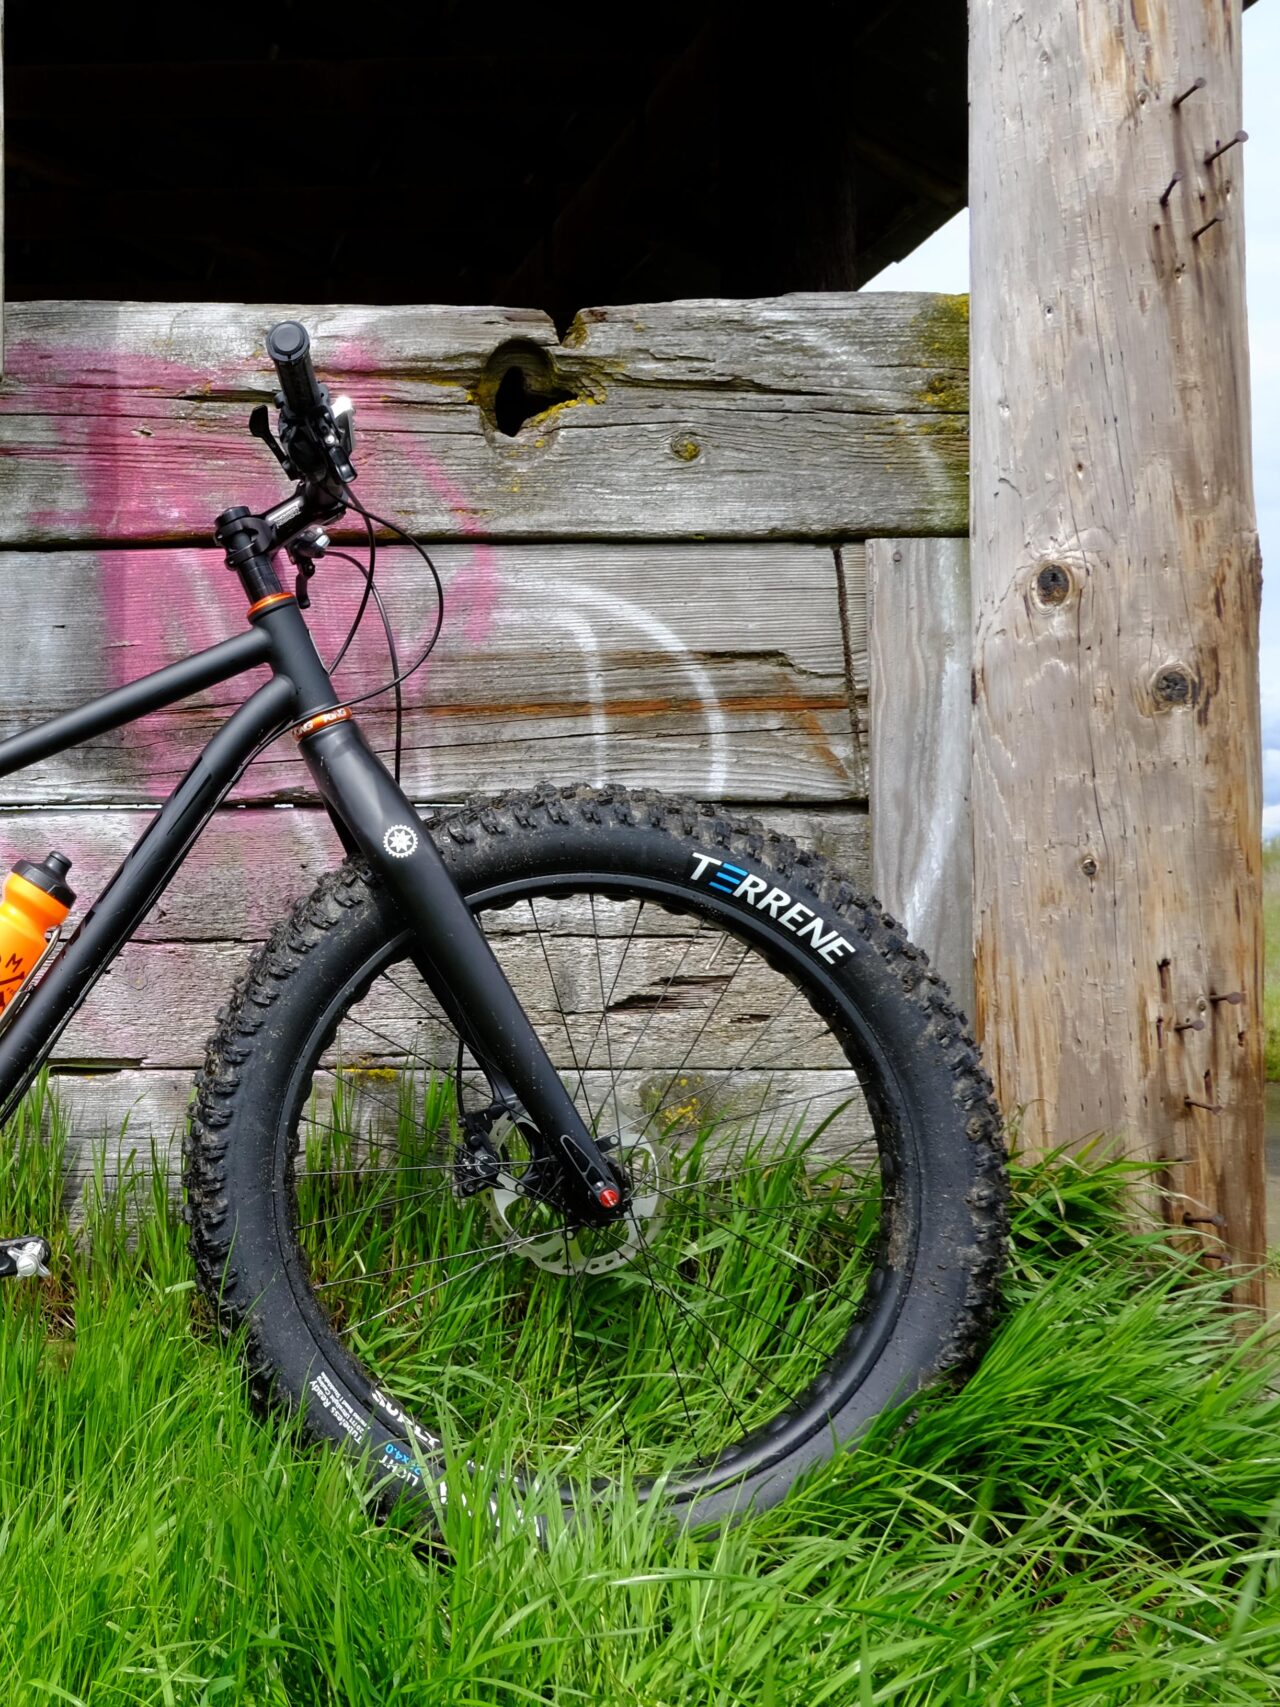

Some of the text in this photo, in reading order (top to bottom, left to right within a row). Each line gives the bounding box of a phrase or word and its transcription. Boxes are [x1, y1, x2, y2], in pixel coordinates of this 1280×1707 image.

[690, 851, 856, 966] TERRENE
[309, 1379, 363, 1444] Tubeless Ready
